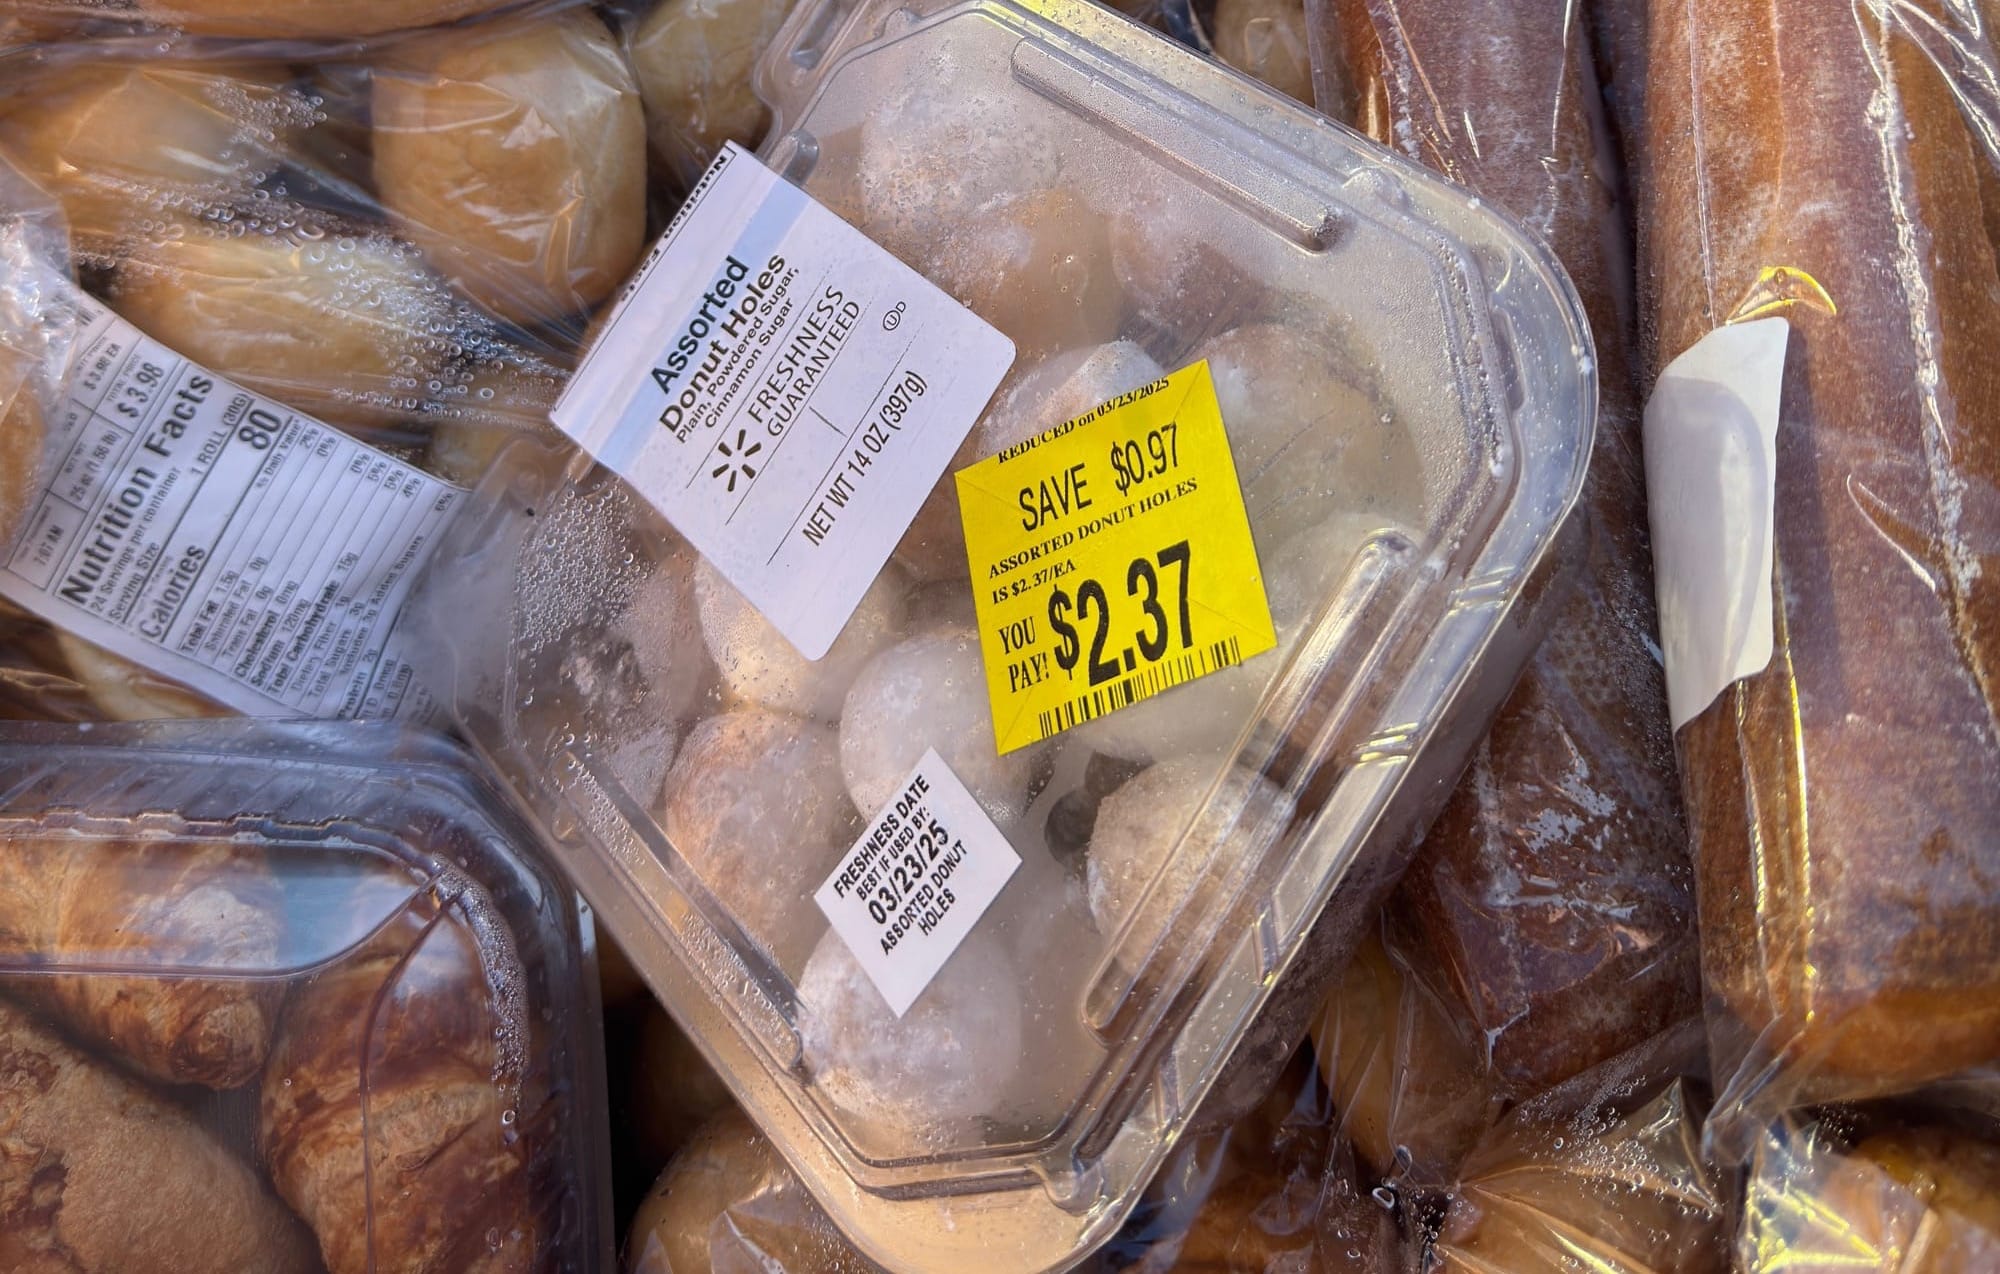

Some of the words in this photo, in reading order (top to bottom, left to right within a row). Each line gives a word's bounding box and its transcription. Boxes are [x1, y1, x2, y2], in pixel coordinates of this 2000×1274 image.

[664, 155, 727, 239] Nutrition
[651, 255, 749, 395] Assorted
[659, 339, 730, 432] Donut
[720, 254, 786, 339] Holes
[676, 401, 712, 444] Plain,
[707, 316, 764, 397] Powdered
[761, 267, 800, 317] Sugar,
[705, 349, 762, 428] Cinnamon
[758, 297, 793, 346] Sugar
[747, 285, 843, 423] FRESHNESS
[767, 301, 860, 437] GUARANTEED
[117, 402, 140, 418] $
[127, 362, 165, 403] 3.98
[238, 408, 281, 451] 80
[997, 419, 1075, 464] REDUCED
[1078, 413, 1095, 428] on
[1096, 377, 1170, 417] 03/23/2025
[191, 466, 203, 475] 1
[197, 430, 228, 464] ROLL
[223, 392, 251, 426] (30G)
[802, 502, 836, 546] NET
[825, 472, 855, 509] WT
[847, 449, 872, 477] 14
[862, 422, 890, 454] OZ
[879, 370, 928, 430] (397g)
[1018, 462, 1093, 532] SAVE
[1111, 422, 1178, 497] $0.97
[60, 466, 158, 605] Nutrition
[144, 376, 213, 457] Facts
[989, 531, 1074, 579] ASSORTED
[1078, 503, 1136, 541] DONUT
[1139, 477, 1198, 514] HOLES
[90, 596, 106, 612] 24
[101, 546, 135, 594] Servings
[130, 524, 146, 545] per
[143, 467, 181, 522] container
[109, 573, 144, 620] Serving
[136, 542, 160, 570] Size
[138, 544, 206, 638] Calories
[286, 580, 340, 662] Carbohydrate
[992, 588, 1008, 604] IS
[998, 615, 1036, 655] YOU
[1048, 539, 1193, 687] $2.37
[234, 609, 280, 679] Cholesterol
[251, 640, 286, 687] Sodium
[282, 599, 312, 633] 120mg
[1008, 651, 1050, 693] PAY!
[833, 814, 900, 899] FRESHNESS
[896, 774, 930, 819] DATE
[856, 868, 882, 901] BEST
[878, 855, 891, 873] IF
[888, 825, 915, 860] USED
[912, 807, 930, 830] BY:
[869, 819, 949, 925] 03/23/25
[880, 884, 934, 956] ASSORTED
[930, 839, 968, 889] DONUT
[918, 888, 957, 936] HOLES
